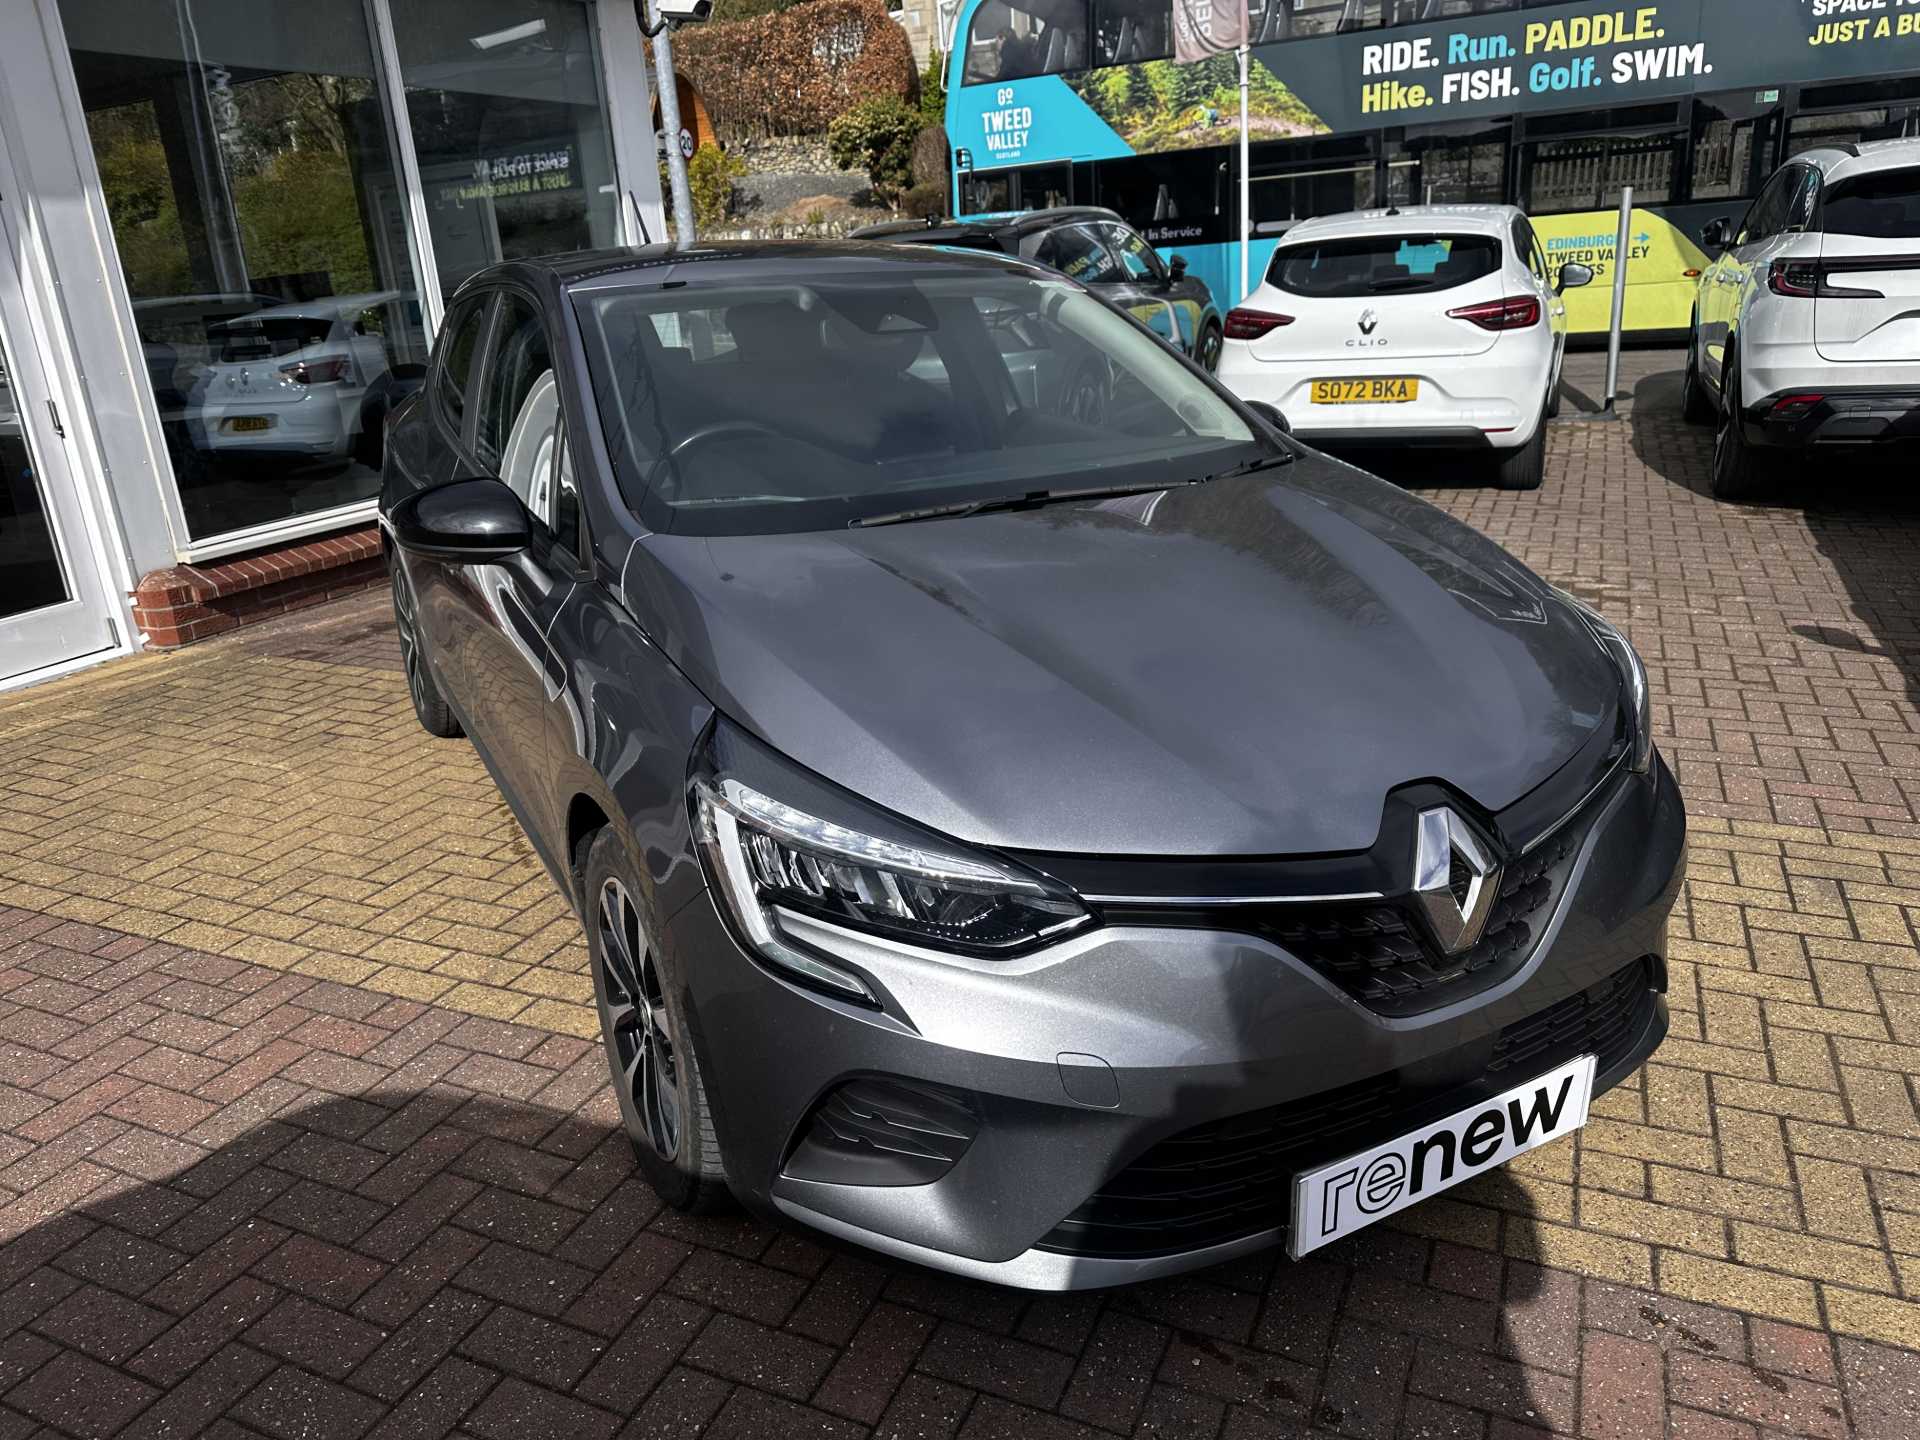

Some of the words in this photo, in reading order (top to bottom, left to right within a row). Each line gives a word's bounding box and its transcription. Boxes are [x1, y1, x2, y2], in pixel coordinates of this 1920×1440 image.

[1362, 37, 1440, 76] RIDE.
[1448, 33, 1516, 65] Run.
[1524, 7, 1665, 55] PADDLE.
[1808, 18, 1871, 46] JUST
[1873, 16, 1891, 38] A
[1361, 80, 1434, 114] Hike.
[1441, 66, 1520, 104] FISH.
[1529, 56, 1602, 93] Golf.
[1611, 42, 1713, 84] SWIM.
[981, 106, 1032, 134] TWEED
[986, 130, 1029, 151] VALLEY
[1148, 227, 1159, 240] In
[1160, 225, 1202, 240] Service
[1547, 234, 1618, 251] EDINBURG
[1546, 249, 1594, 265] TWEED
[1597, 245, 1650, 261] VAEY
[1345, 338, 1388, 347] CLIO
[1371, 380, 1408, 399] BKA
[1321, 1074, 1574, 1237] renew
